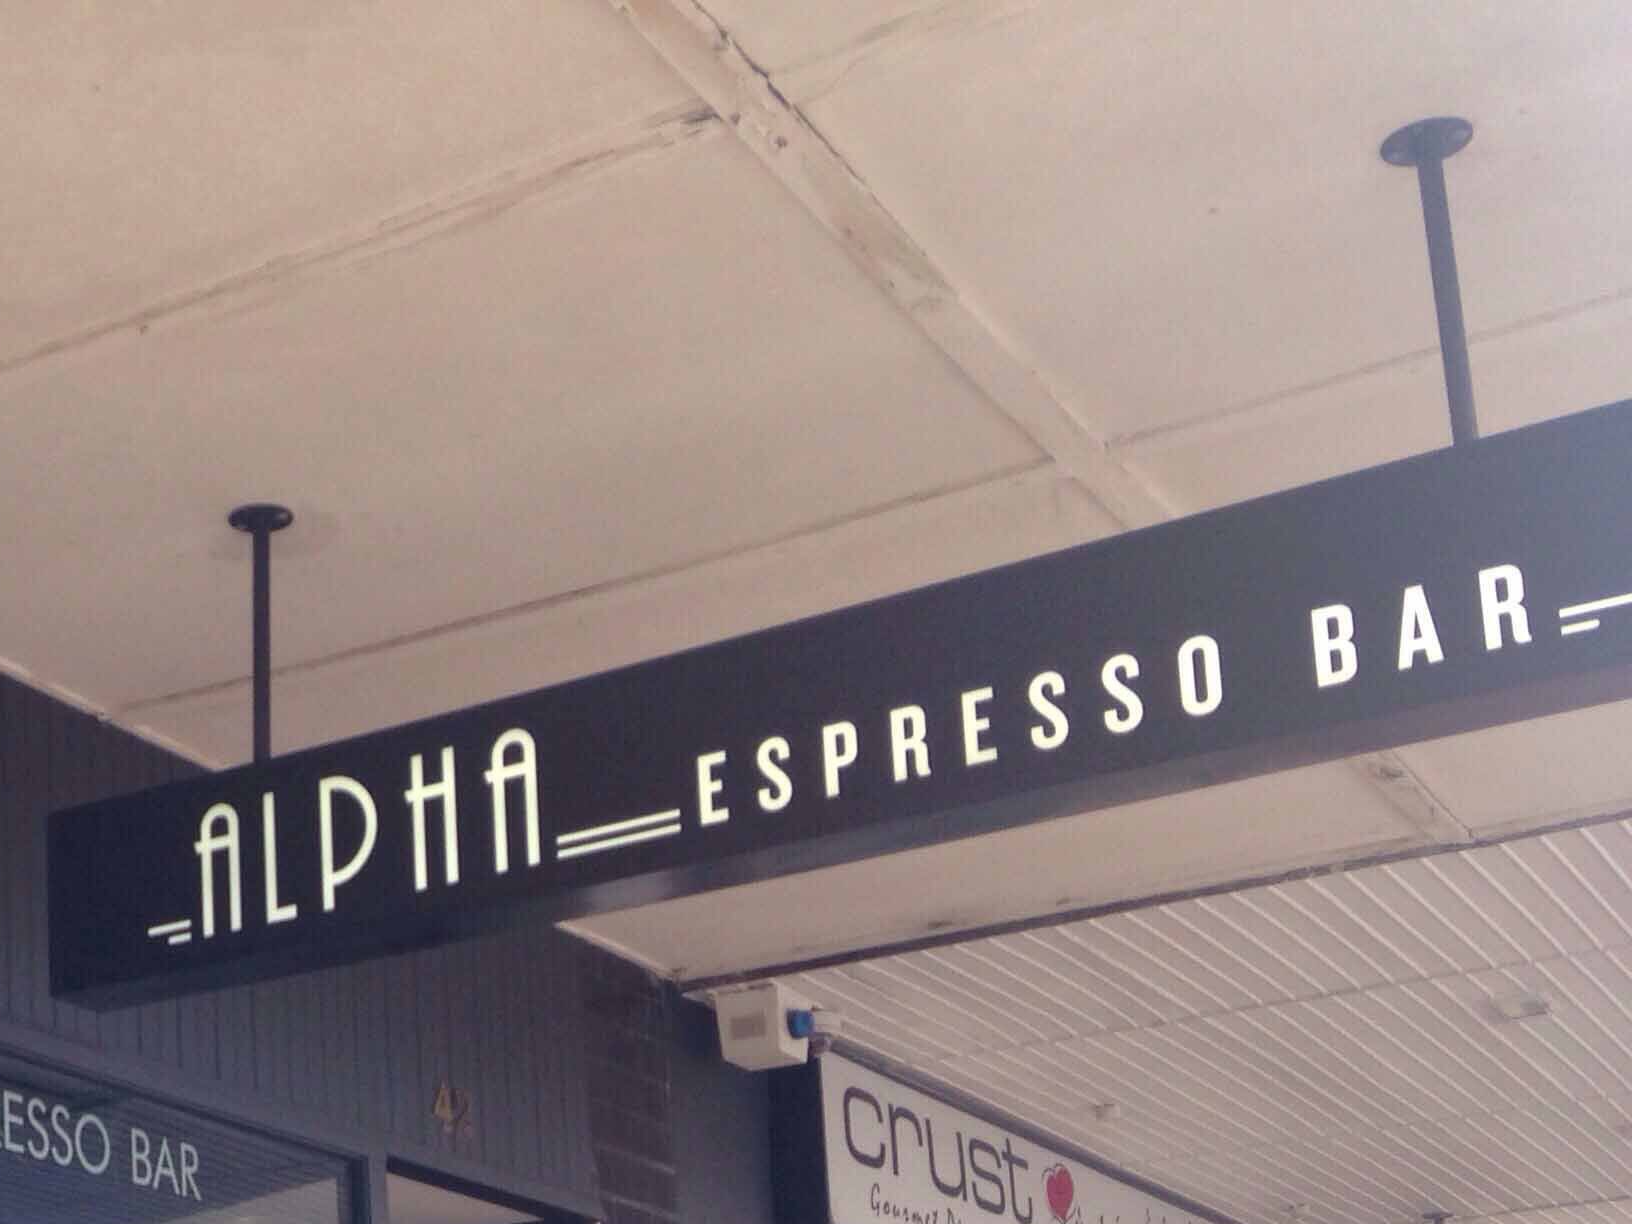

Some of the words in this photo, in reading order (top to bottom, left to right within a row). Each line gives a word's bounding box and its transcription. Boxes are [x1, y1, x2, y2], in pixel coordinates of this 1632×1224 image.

[194, 728, 541, 938] ALPHA
[696, 634, 1224, 827] ESPRESSO
[1310, 563, 1532, 689] BAR
[131, 1126, 202, 1201] BAR
